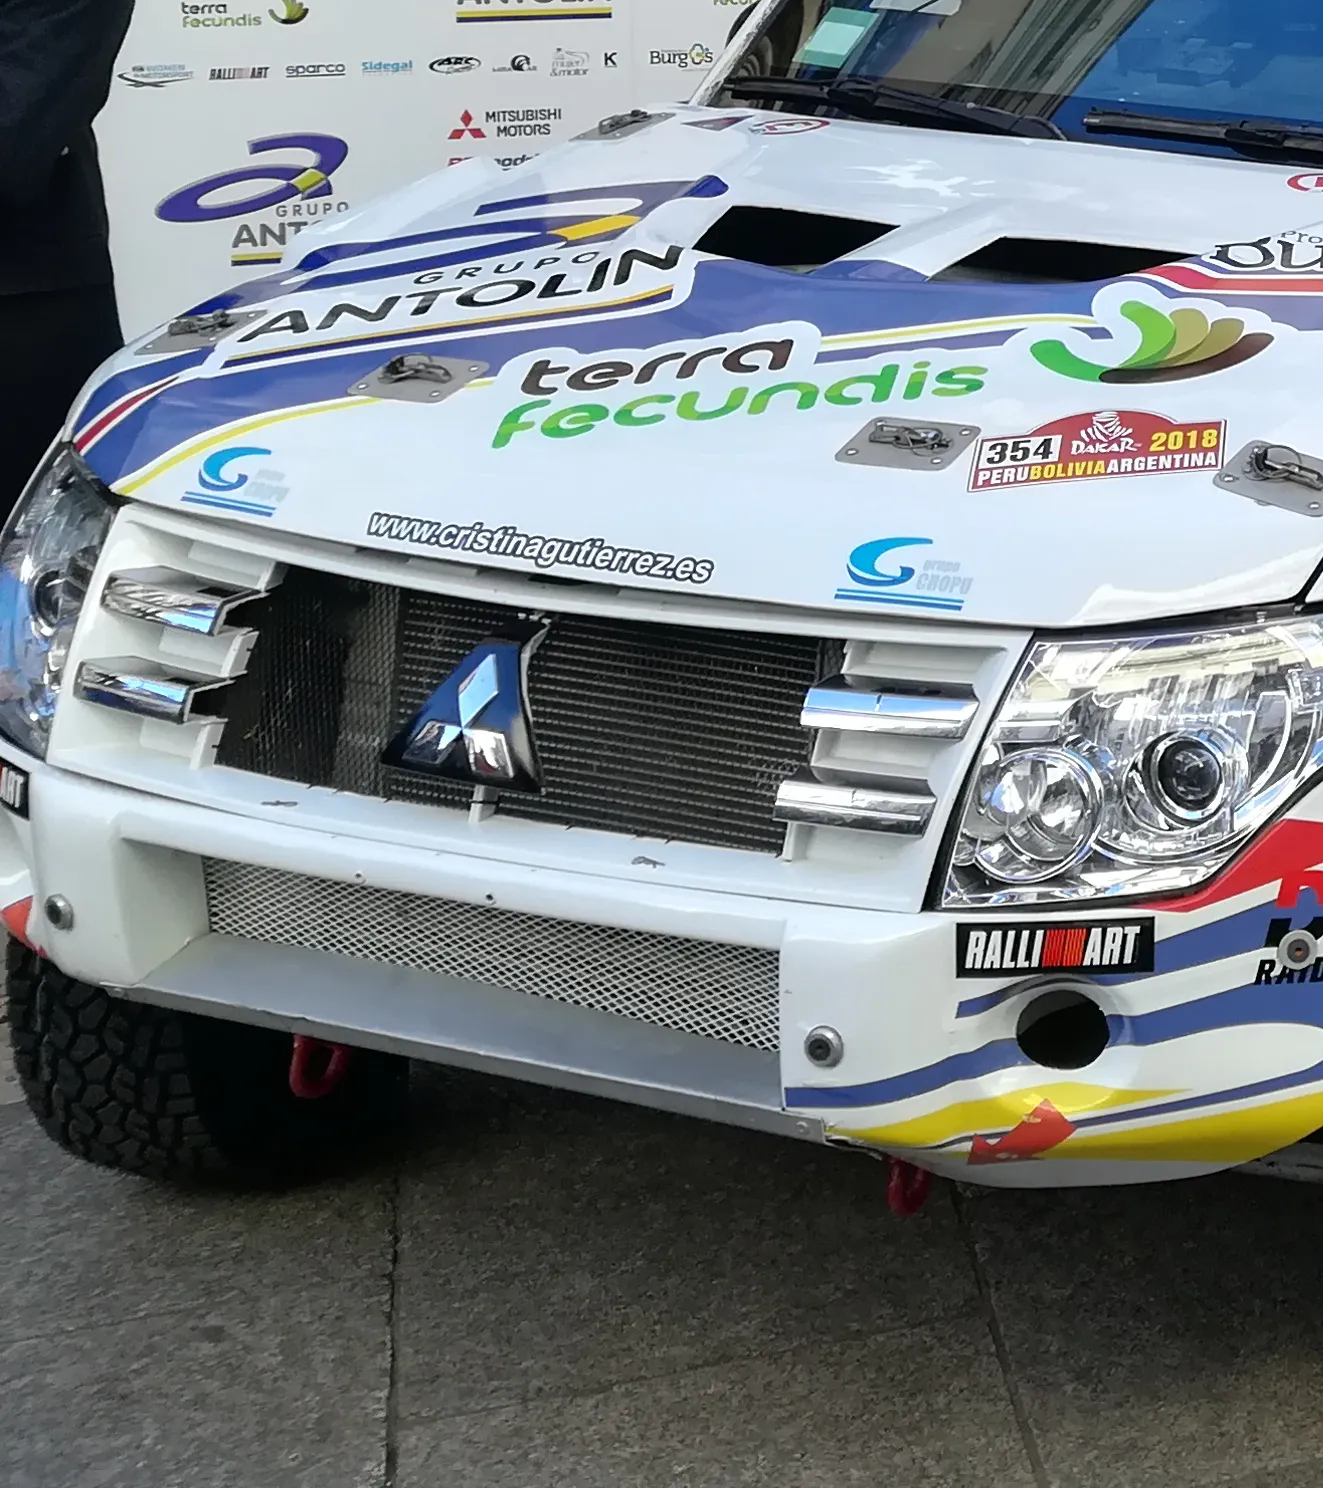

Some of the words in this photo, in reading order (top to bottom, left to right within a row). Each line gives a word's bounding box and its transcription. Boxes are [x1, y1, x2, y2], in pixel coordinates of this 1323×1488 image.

[181, 1, 227, 15] terra
[182, 13, 262, 28] fecundis
[285, 63, 346, 76] sparco
[361, 60, 413, 73] Sidegal
[485, 109, 562, 123] MITSUBISHI
[496, 124, 551, 137] MOTORS
[276, 201, 350, 218] GRUPO
[413, 252, 601, 285] GRUPO
[238, 246, 685, 343] ANTOLIN
[519, 338, 796, 398] terra
[491, 361, 988, 449] fecundis
[985, 439, 1056, 465] 354
[1149, 429, 1220, 452] 2018
[367, 512, 715, 585] www.cristinagutierrez.es
